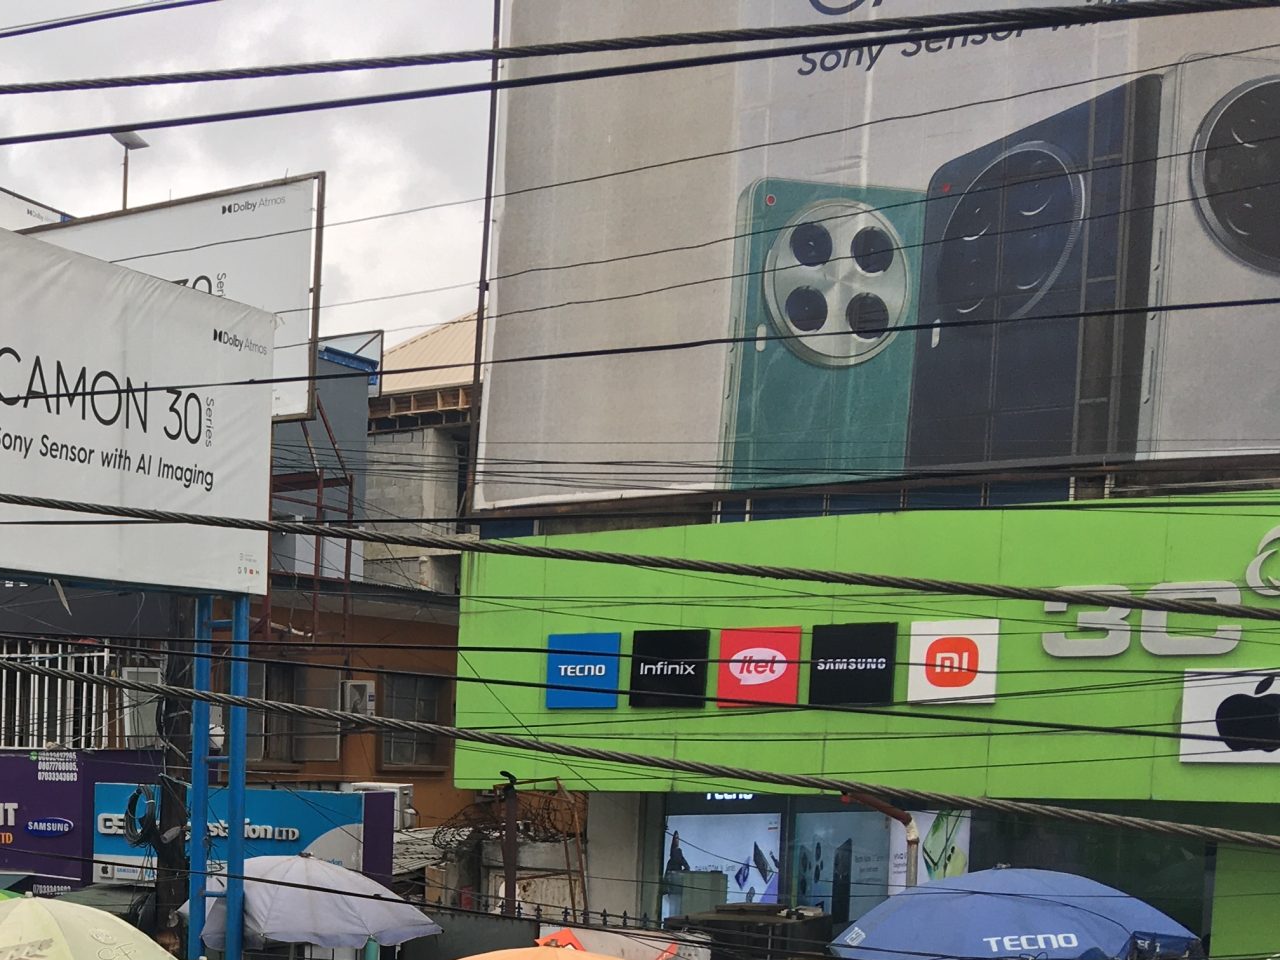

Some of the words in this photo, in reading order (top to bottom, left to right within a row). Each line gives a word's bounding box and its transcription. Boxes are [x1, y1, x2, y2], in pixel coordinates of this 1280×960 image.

[233, 199, 258, 215] Dolby
[222, 329, 244, 350] Dolby
[162, 387, 203, 445] 30
[204, 396, 215, 448] Series
[39, 434, 95, 465] Sensor
[100, 447, 131, 475] with
[135, 452, 152, 476] AI
[157, 457, 214, 492] Imaging
[1041, 580, 1242, 658] 3C
[558, 662, 606, 677] TECNO
[639, 661, 696, 676] Infinix
[738, 655, 777, 675] itel
[816, 657, 887, 671] SAMSUNG
[27, 820, 70, 832] SAMSUNG
[274, 827, 300, 842] LTD
[983, 932, 1079, 952] TECNO
